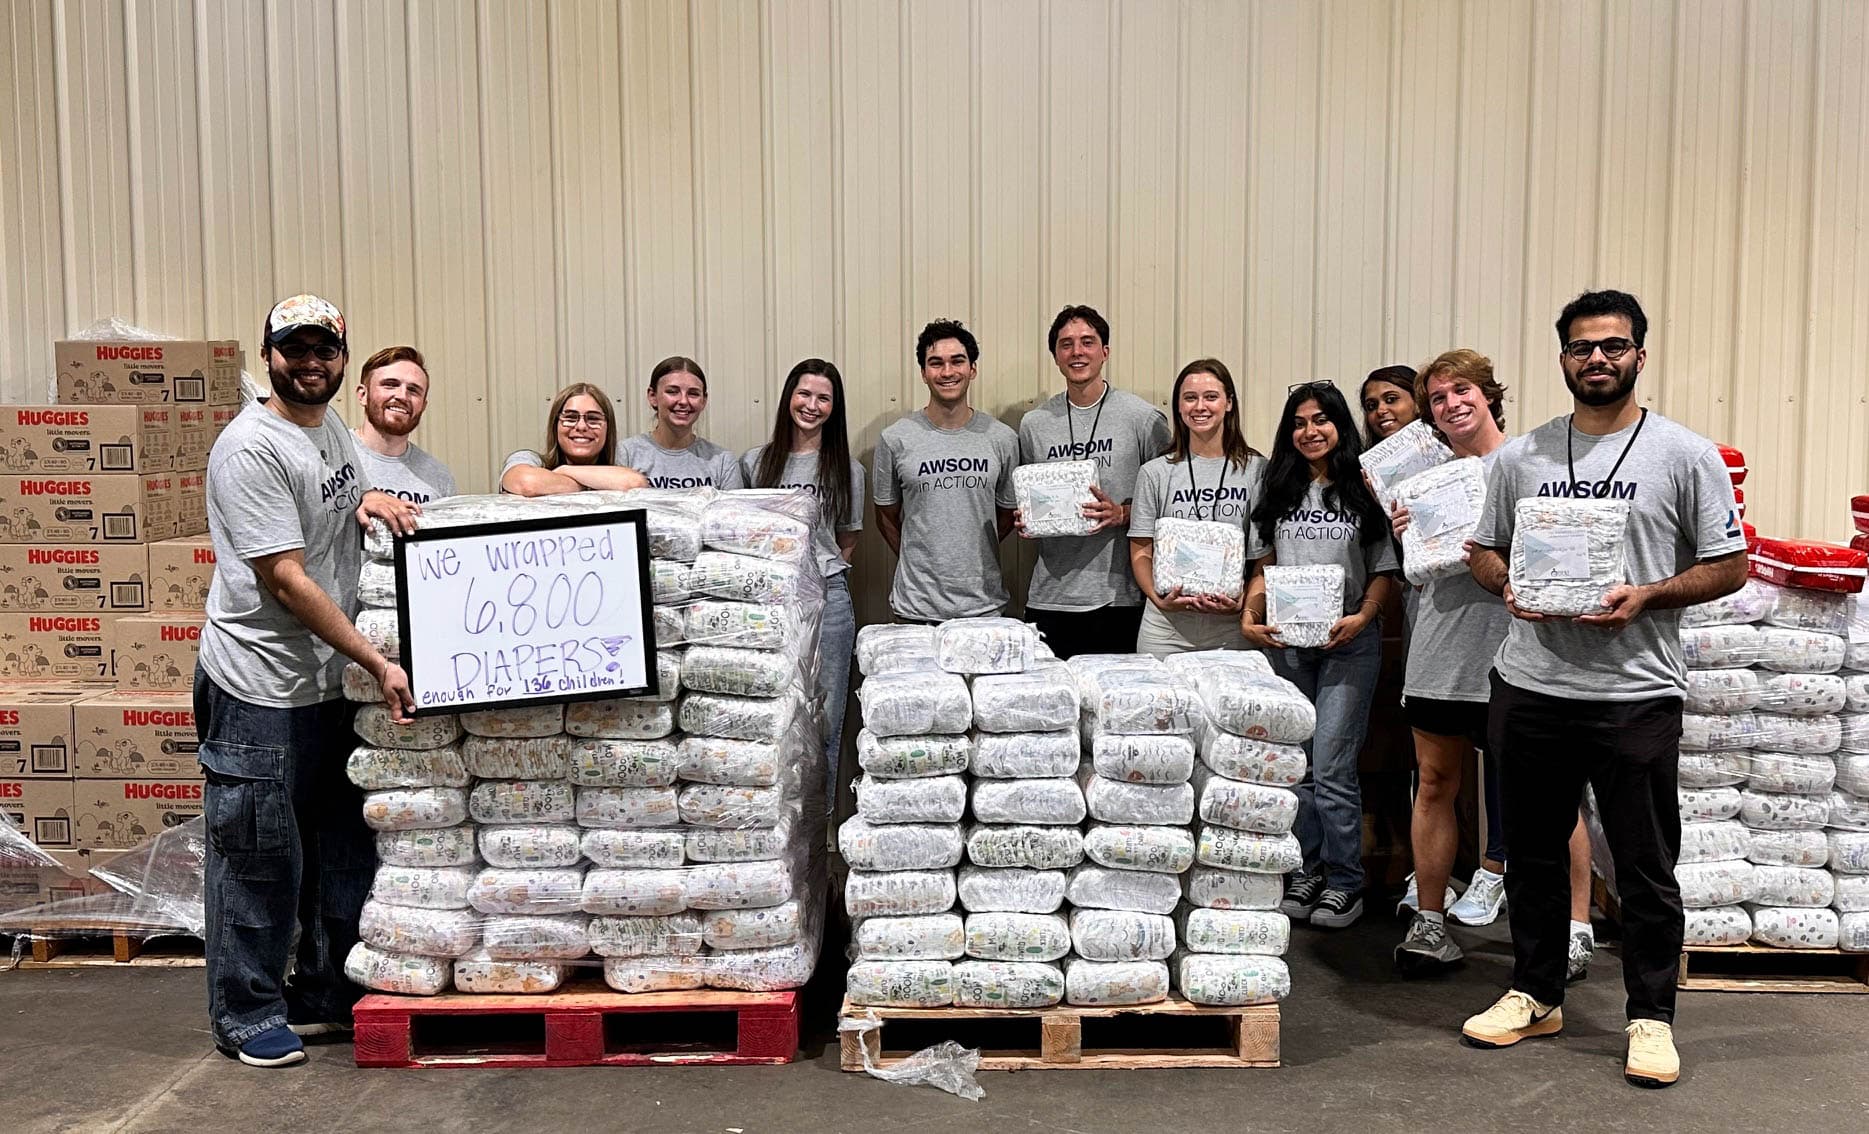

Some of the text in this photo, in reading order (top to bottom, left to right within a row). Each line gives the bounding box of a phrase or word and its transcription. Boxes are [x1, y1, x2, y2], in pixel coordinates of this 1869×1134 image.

[96, 346, 163, 360] HUGGIES
[160, 389, 170, 402] 7
[18, 410, 89, 426] HUGGIES
[46, 428, 64, 436] little
[1046, 438, 1112, 460] AWSOM
[86, 458, 96, 471] 7
[918, 458, 988, 476] AWSOM
[20, 480, 91, 495] HUGGIES
[919, 476, 988, 493] in ACTION
[1537, 480, 1638, 500] AWSOM
[1171, 487, 1247, 504] AWSOM
[1188, 503, 1245, 519] ACTION
[88, 527, 99, 540] 7
[1279, 526, 1355, 541] in ACTION
[28, 549, 100, 564] HUGGIES
[486, 529, 614, 572] wrapped
[96, 595, 106, 608] 7
[464, 571, 604, 636] 6,800
[29, 616, 100, 632] HUGGIES
[97, 663, 107, 676] 7
[422, 687, 475, 705] enough
[487, 683, 512, 697] for
[524, 675, 552, 694] 136
[16, 759, 27, 773] 7
[124, 783, 202, 799] HUGGIES
